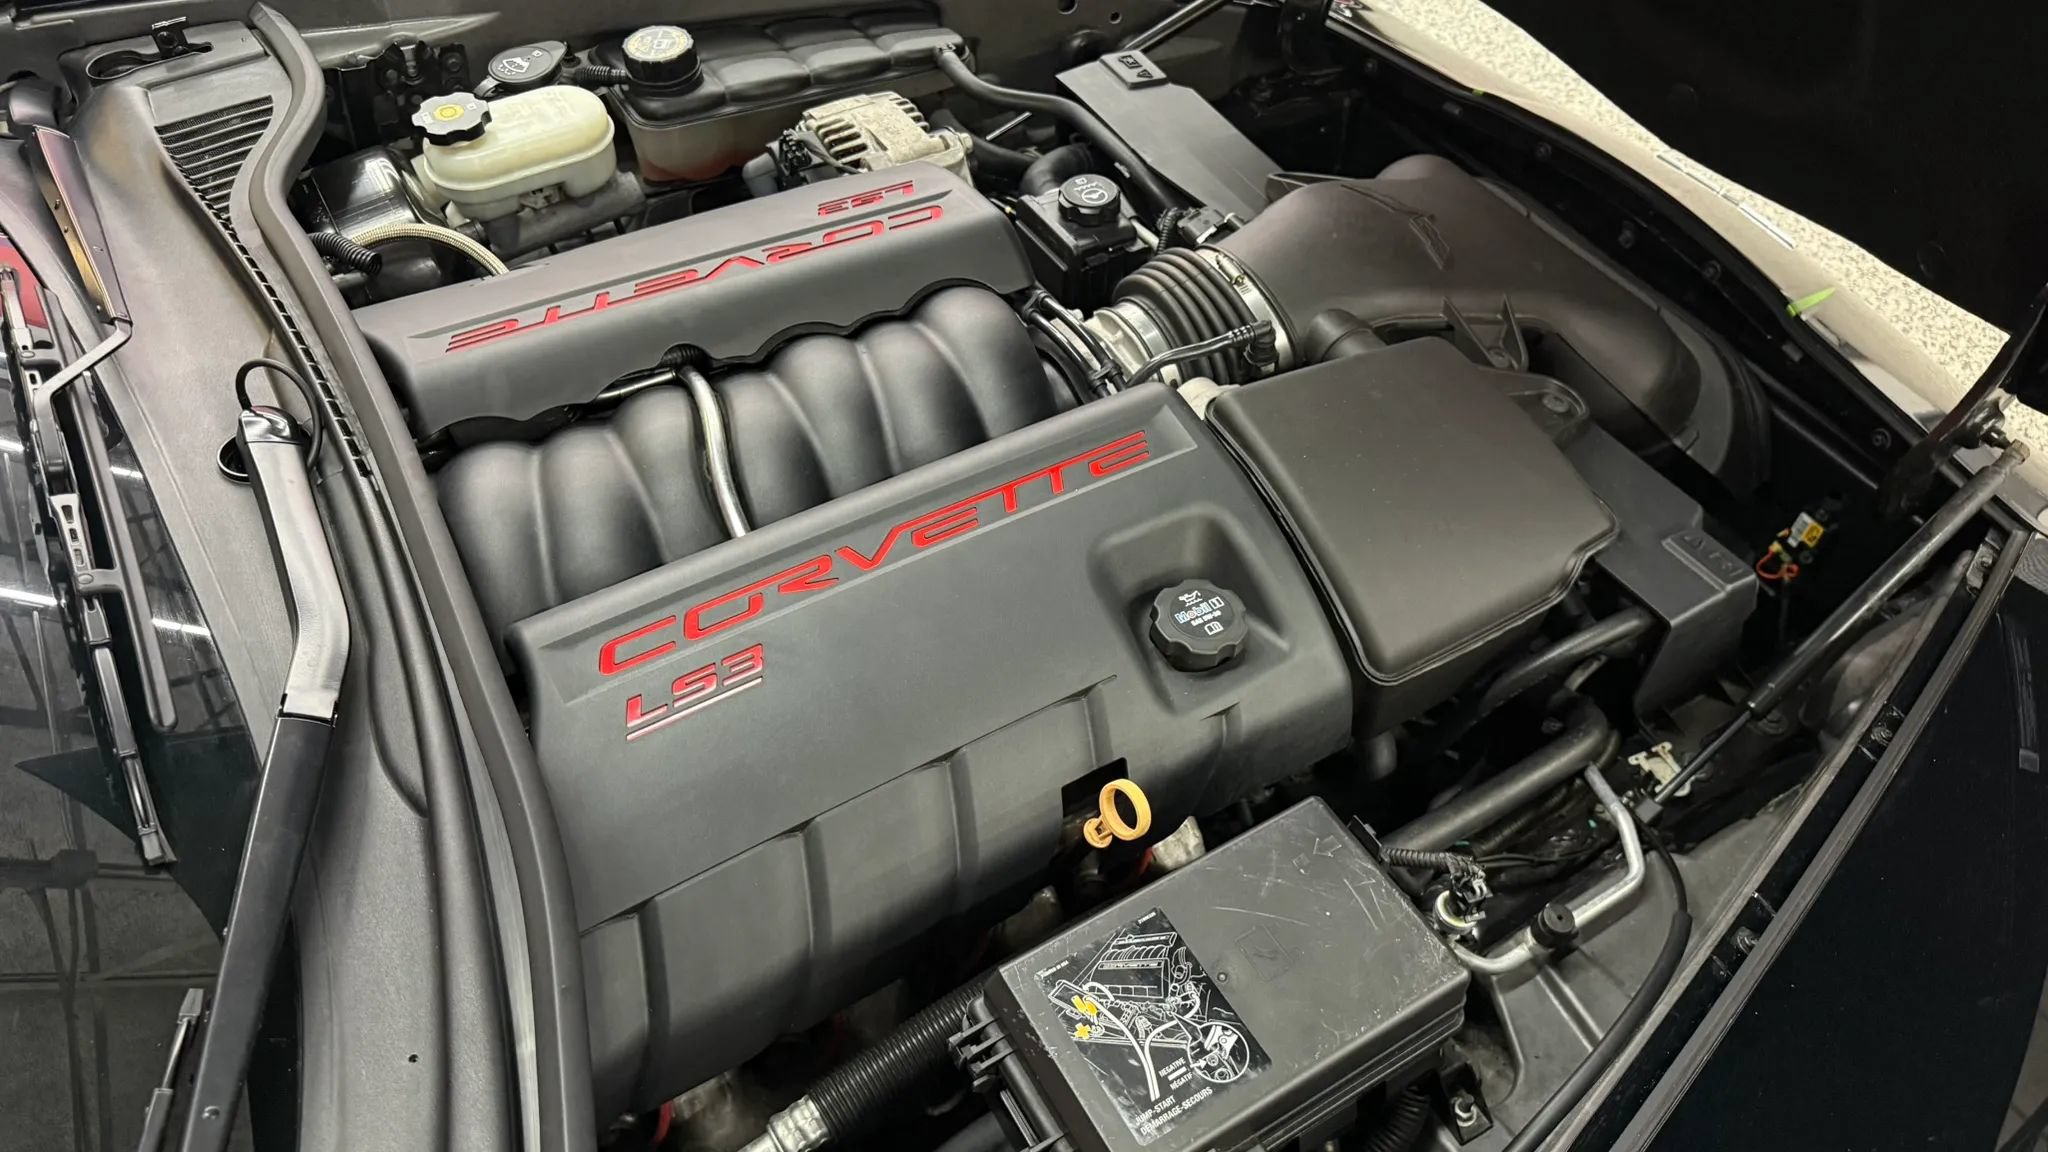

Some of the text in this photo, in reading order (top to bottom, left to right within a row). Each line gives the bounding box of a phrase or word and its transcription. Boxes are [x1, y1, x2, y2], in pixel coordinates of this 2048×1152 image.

[817, 181, 915, 216] LS3
[446, 204, 945, 353] CORVETTE
[599, 430, 1150, 677] CORVETTE
[1174, 602, 1213, 624] Mobil
[626, 642, 765, 728] LS3
[1158, 1056, 1187, 1078] NEGATIVE
[1135, 1094, 1176, 1126] JUMP-START
